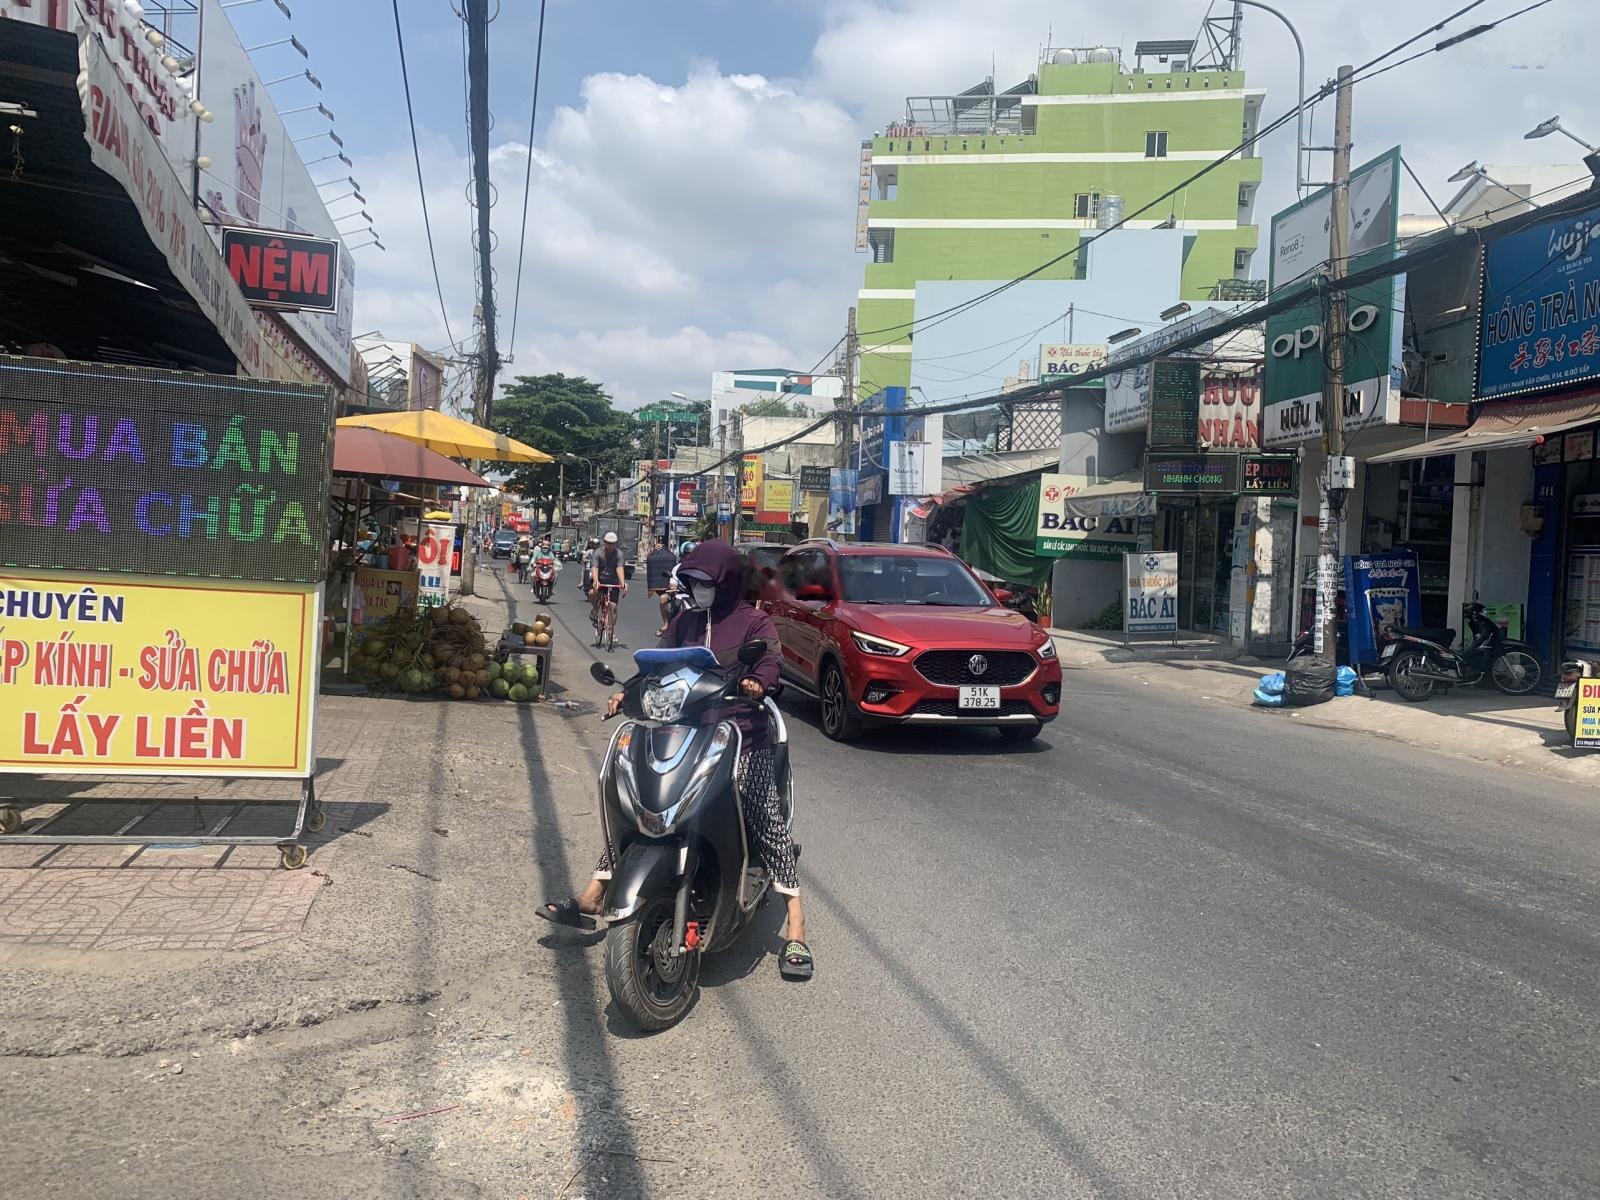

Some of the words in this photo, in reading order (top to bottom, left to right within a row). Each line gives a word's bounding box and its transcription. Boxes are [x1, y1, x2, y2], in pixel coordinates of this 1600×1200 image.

[228, 239, 330, 300] NỆM
[1485, 296, 1536, 347] HỒNG
[1540, 279, 1579, 331] TRÀ
[1047, 359, 1080, 373] BÁC
[0, 409, 146, 463] MUA
[170, 414, 300, 475] BÁN
[1197, 413, 1261, 448] NHÂN
[1163, 474, 1192, 483] NHANH
[133, 482, 314, 546] CHỮA
[1142, 573, 1161, 587] THUỐC
[0, 587, 125, 622] HUYÊN
[1129, 591, 1157, 618] BÁC
[1160, 591, 1175, 618] ÁI
[34, 630, 111, 688] KÍNH
[138, 629, 201, 692] SỬA
[207, 639, 289, 695] CHỮA
[963, 697, 996, 707] 378.25
[971, 687, 989, 697] 51K
[1583, 685, 1600, 698] ĐI
[23, 696, 120, 757] LẤY
[136, 700, 243, 759] LIỀN
